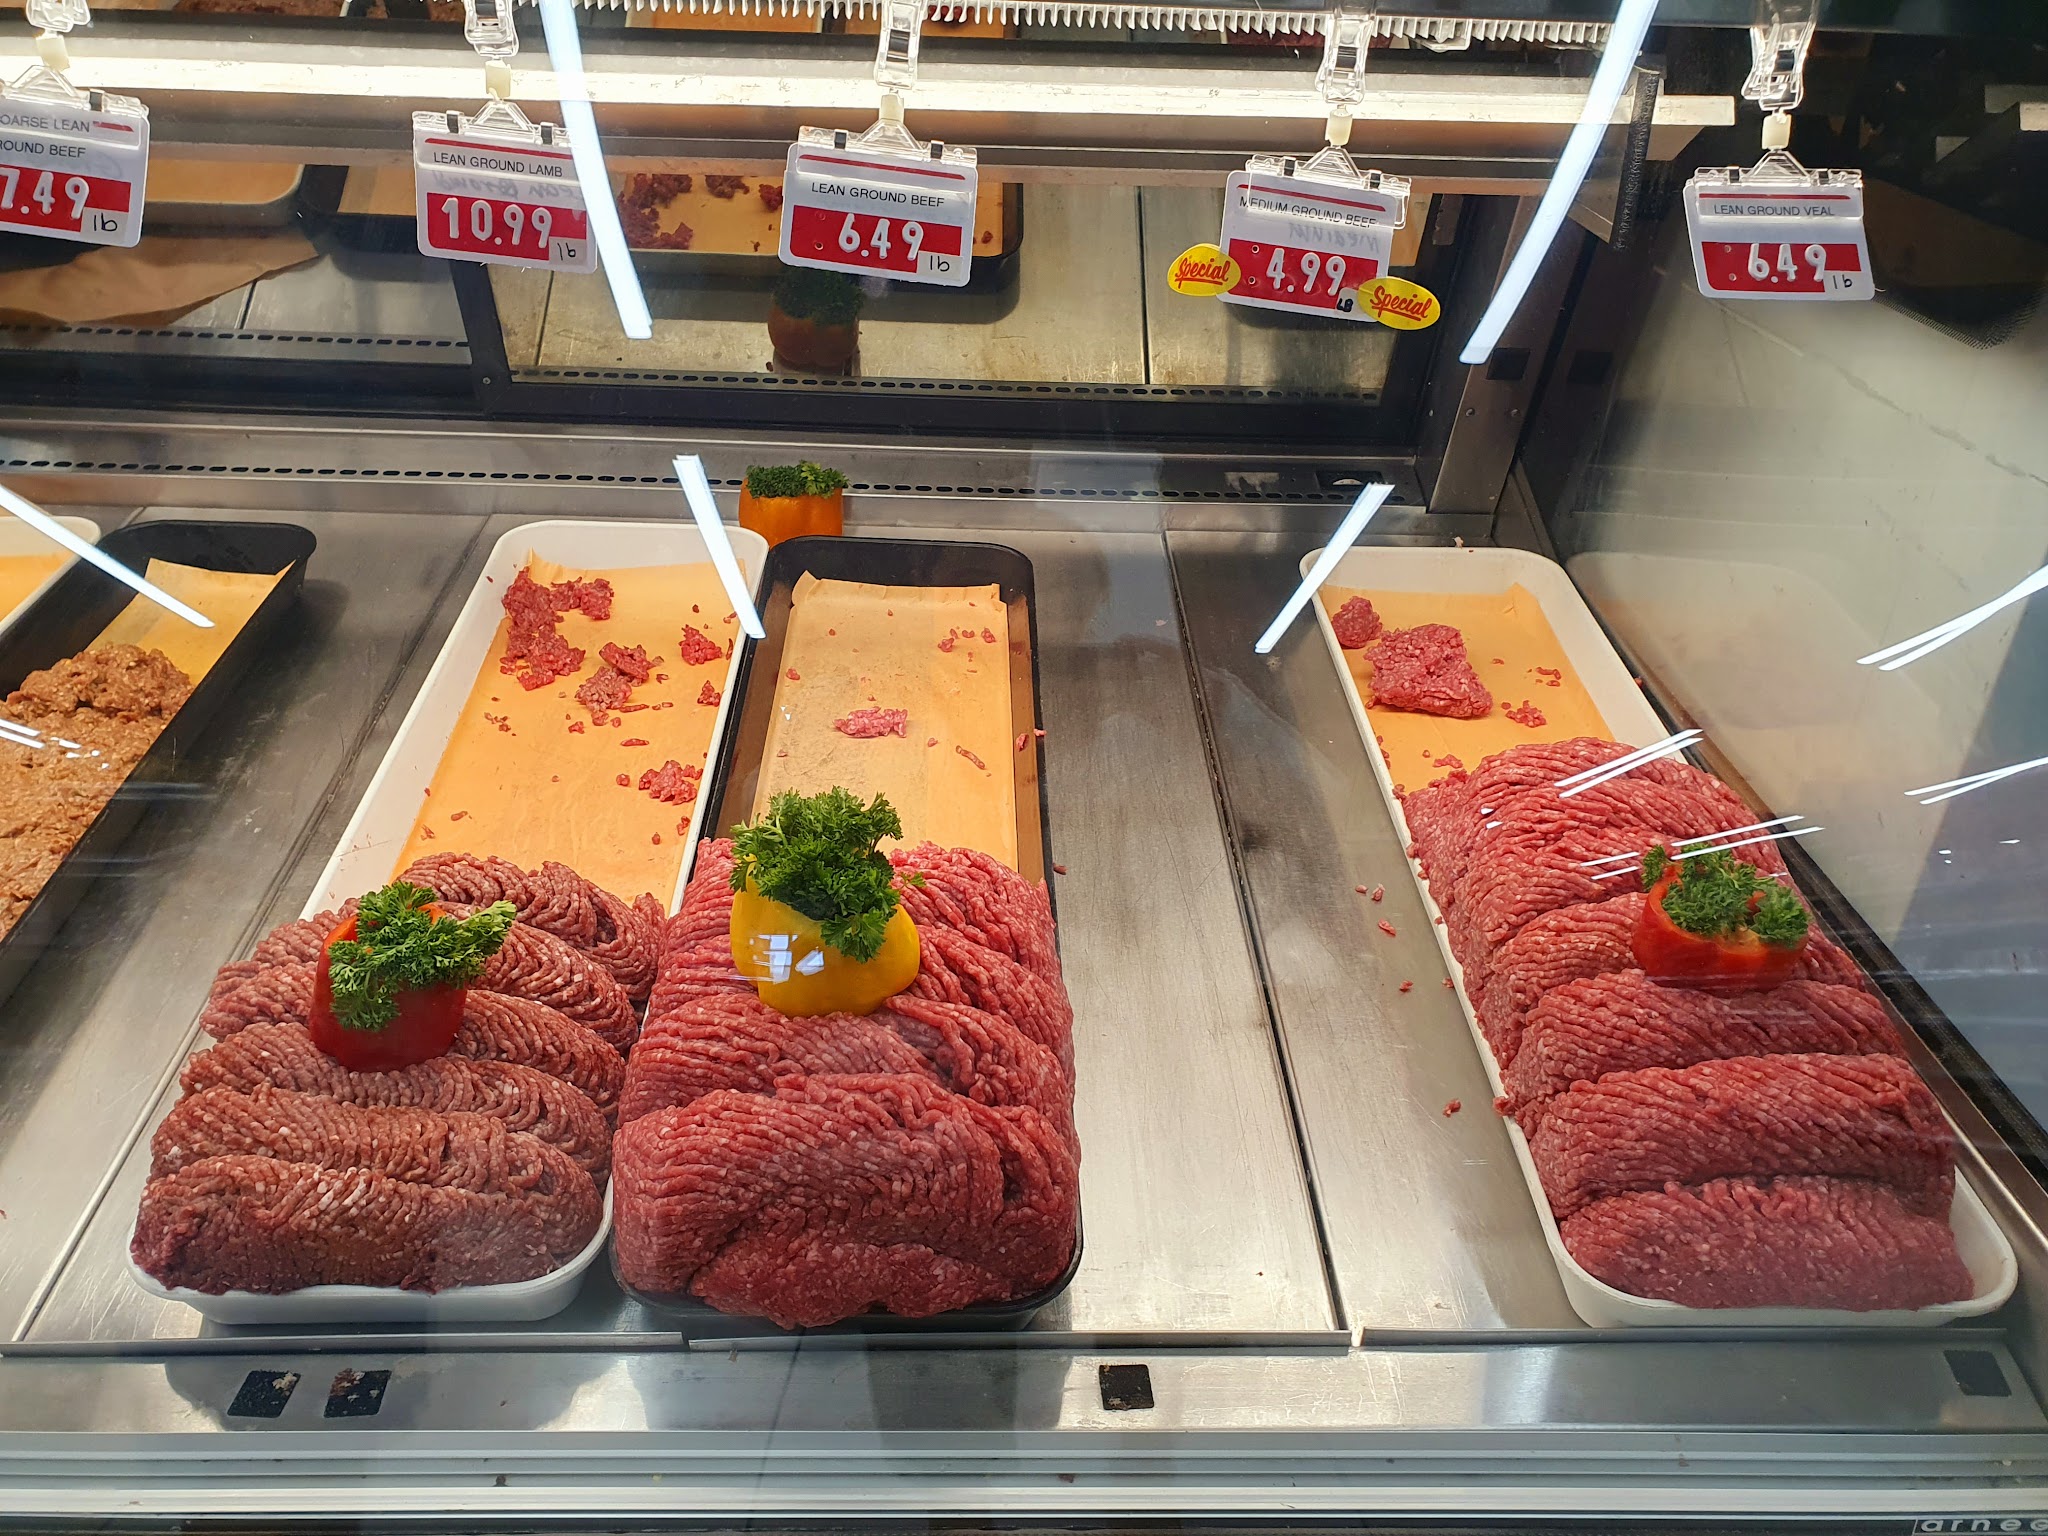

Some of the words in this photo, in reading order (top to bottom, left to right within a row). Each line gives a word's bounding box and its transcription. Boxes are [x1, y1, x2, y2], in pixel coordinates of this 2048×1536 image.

[54, 118, 90, 133] LEAN
[0, 140, 45, 155] OUND
[50, 144, 86, 158] BEEF
[433, 151, 466, 166] LEAN
[470, 156, 525, 173] GROUND
[529, 164, 563, 178] LAMB
[0, 167, 90, 220] 7.49
[93, 213, 118, 232] lb
[811, 181, 846, 196] LEAN
[850, 187, 907, 204] GROUND
[911, 194, 945, 208] BEEF
[1714, 204, 1744, 215] LEAN
[1747, 204, 1801, 216] GROUND
[1804, 206, 1835, 216] VEAL
[441, 197, 553, 249] 10.99
[1239, 196, 1288, 214] MEDIUM
[1291, 204, 1343, 223] GROUND
[1345, 213, 1377, 229] BEEF
[838, 213, 924, 261] 6.49
[929, 254, 951, 273] lb
[1174, 257, 1231, 290] Special
[1747, 243, 1827, 282] 6.49
[1266, 247, 1346, 297] 4.99
[1336, 297, 1354, 313] LB
[1369, 285, 1433, 319] Special
